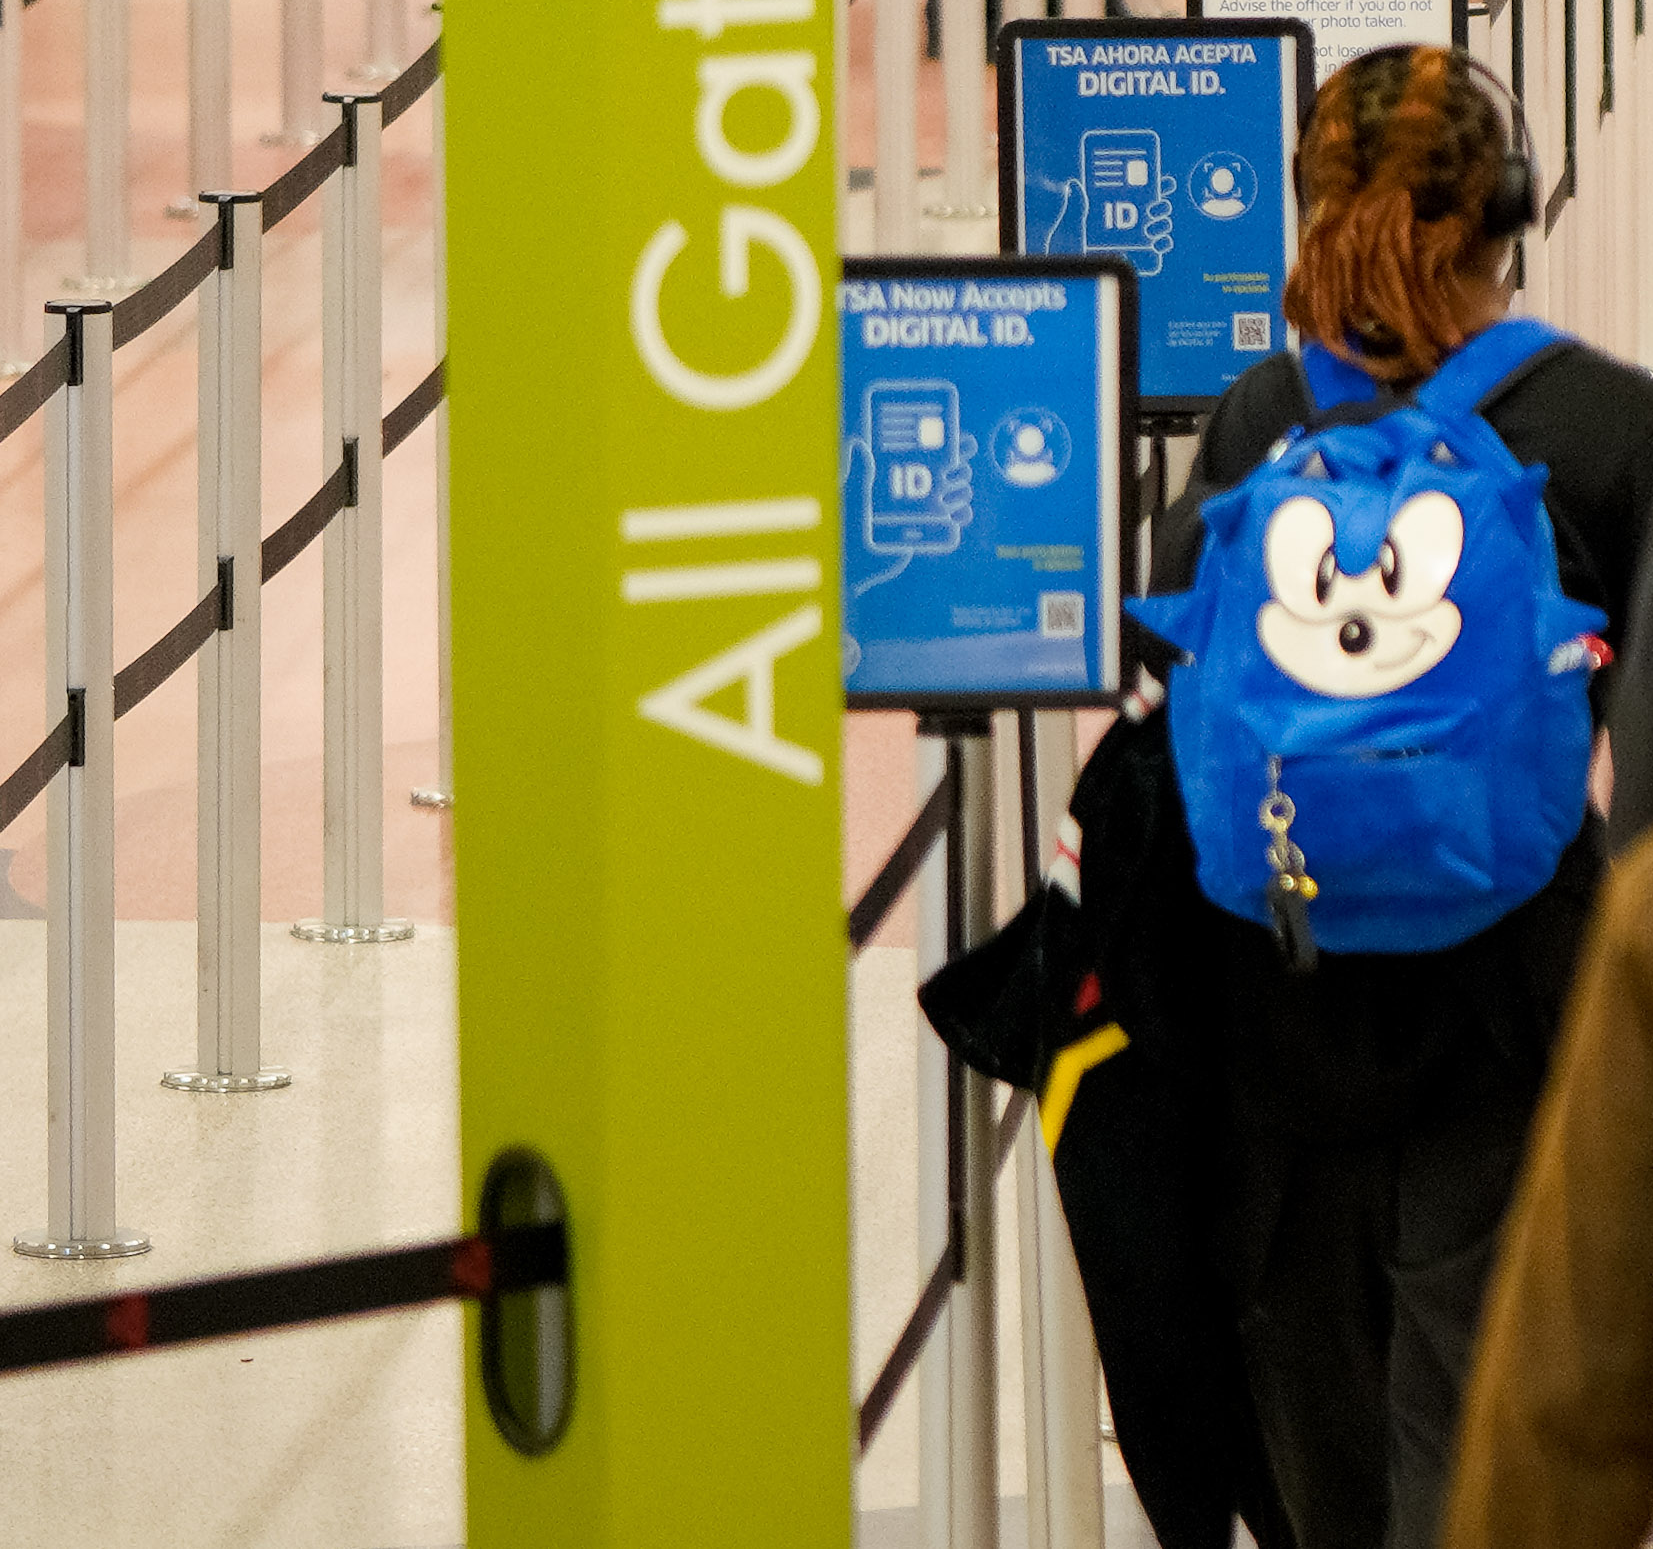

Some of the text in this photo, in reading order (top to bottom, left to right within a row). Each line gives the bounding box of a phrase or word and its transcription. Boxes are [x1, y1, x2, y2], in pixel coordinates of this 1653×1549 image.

[1219, 0, 1433, 13] Advise the officer if you do not
[1321, 15, 1361, 30] photo
[1365, 15, 1406, 28] taken.
[1046, 44, 1257, 67] TSA AHORA ACEPTA
[1079, 70, 1227, 96] DIGITAL ID.
[1103, 202, 1139, 230] ID
[891, 282, 955, 309] Now
[961, 281, 1067, 313] Accepts
[864, 314, 1035, 347] DIGITAL ID.
[889, 462, 933, 499] ID
[620, 495, 826, 785] All
